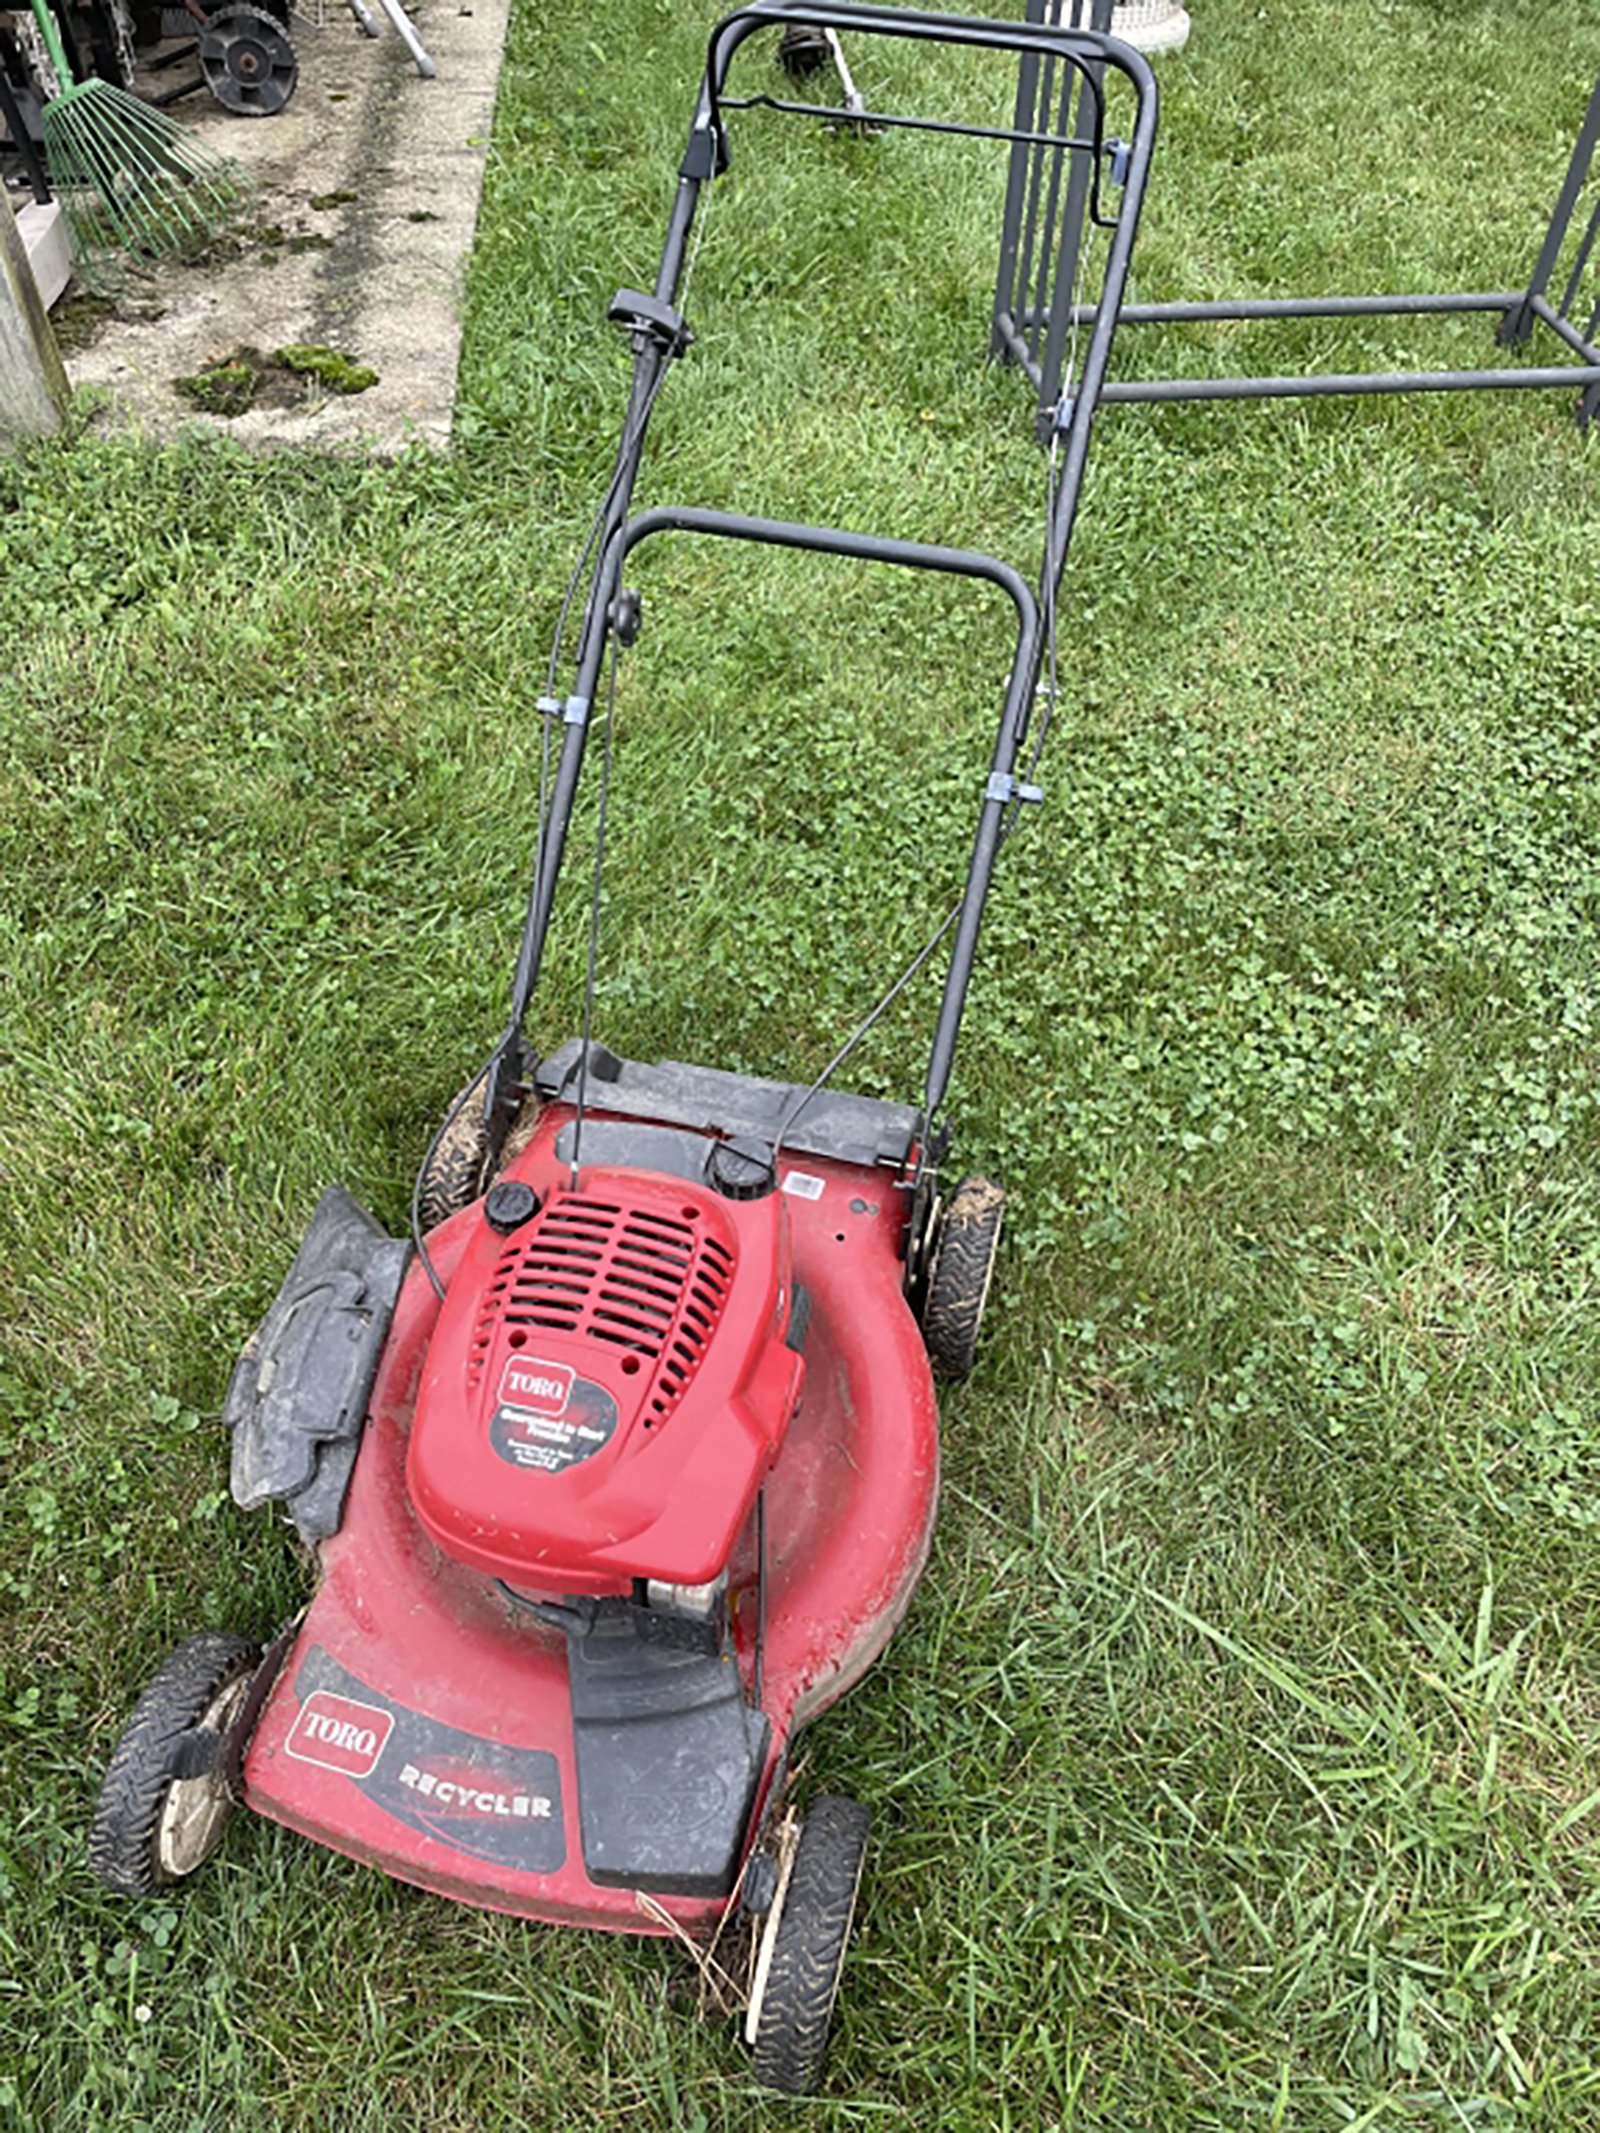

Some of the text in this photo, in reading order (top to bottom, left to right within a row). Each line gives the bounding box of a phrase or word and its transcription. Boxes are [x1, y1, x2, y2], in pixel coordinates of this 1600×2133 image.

[508, 1371, 564, 1400] TORO
[303, 1711, 377, 1757] TORO
[398, 1763, 553, 1818] RECYCLER
